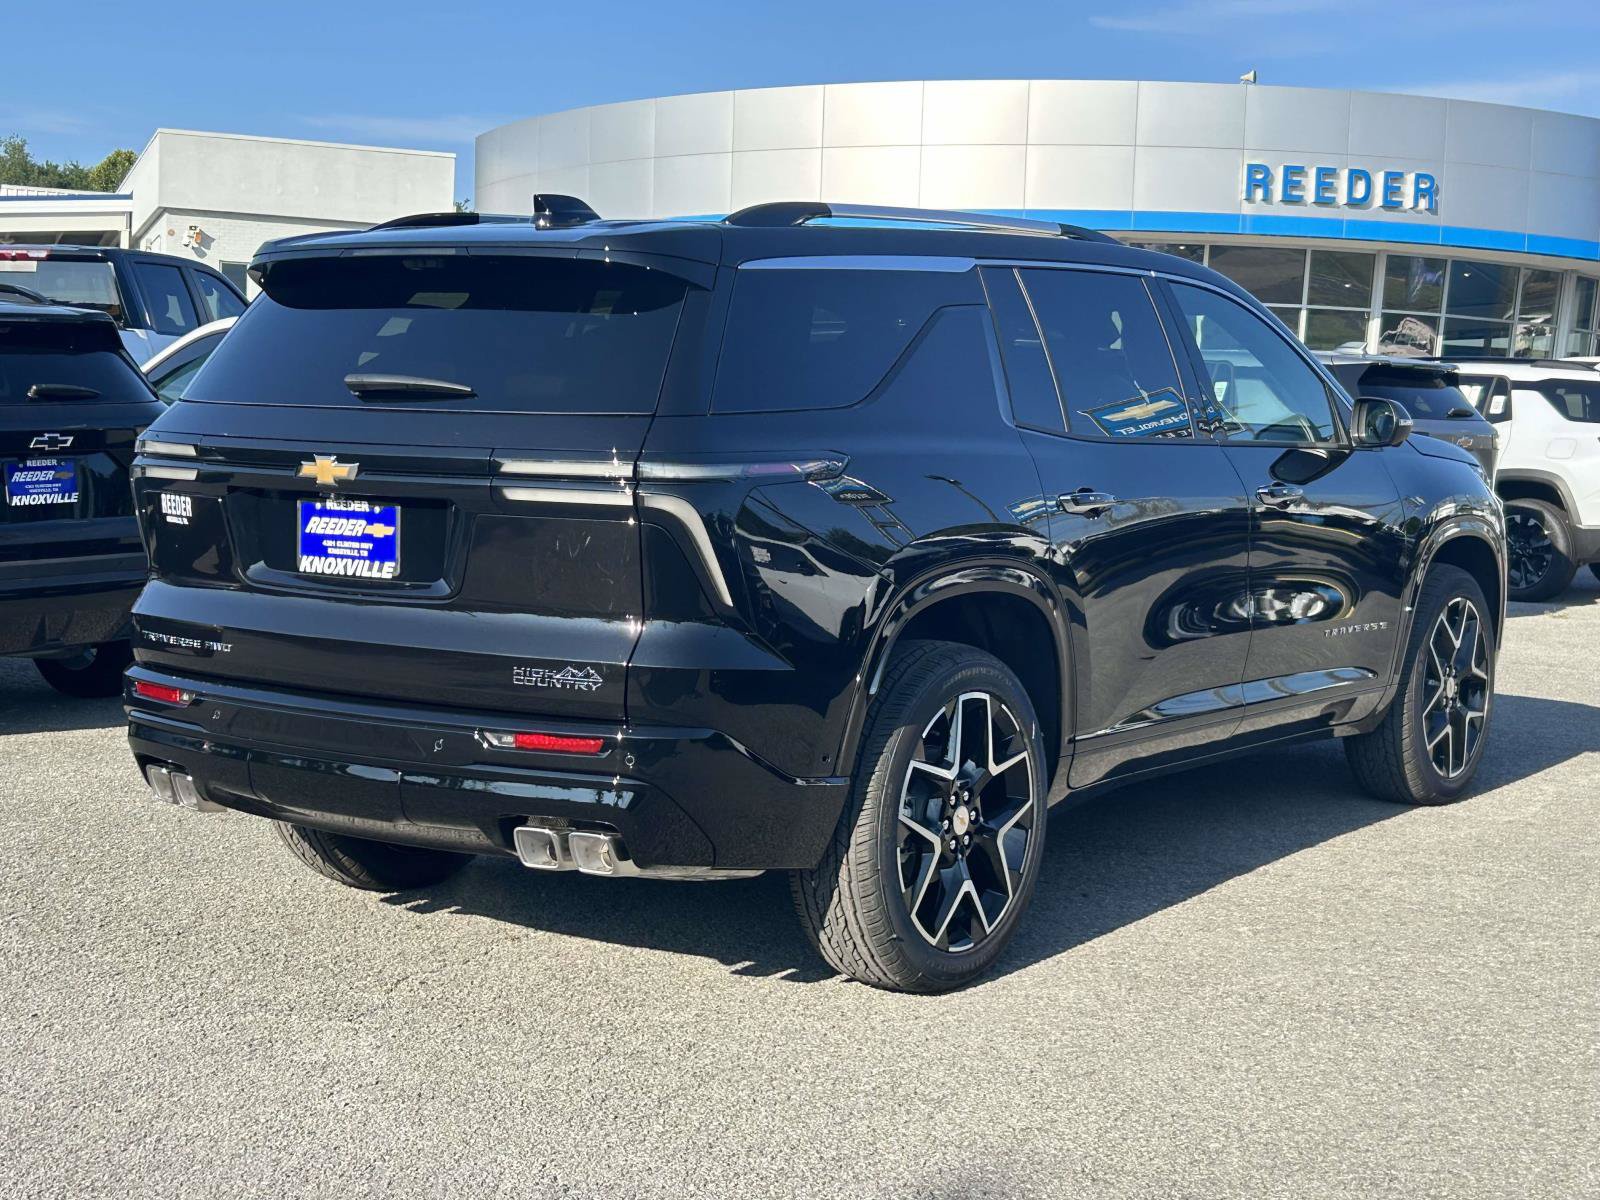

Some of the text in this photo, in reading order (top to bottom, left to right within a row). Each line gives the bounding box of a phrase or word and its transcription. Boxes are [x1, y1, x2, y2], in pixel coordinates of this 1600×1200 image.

[1244, 163, 1437, 212] REEDER
[26, 459, 58, 467] REEDER
[12, 471, 55, 482] REEDER
[12, 492, 79, 506] KNOXVILLE
[161, 493, 192, 517] REEDER
[326, 499, 370, 512] REEDER
[305, 516, 367, 536] REEDER
[299, 555, 396, 578] KNOXVILLE
[1324, 621, 1388, 637] TRAVERSE
[142, 630, 202, 649] TRAVERSE
[513, 676, 603, 691] COUNTRY
